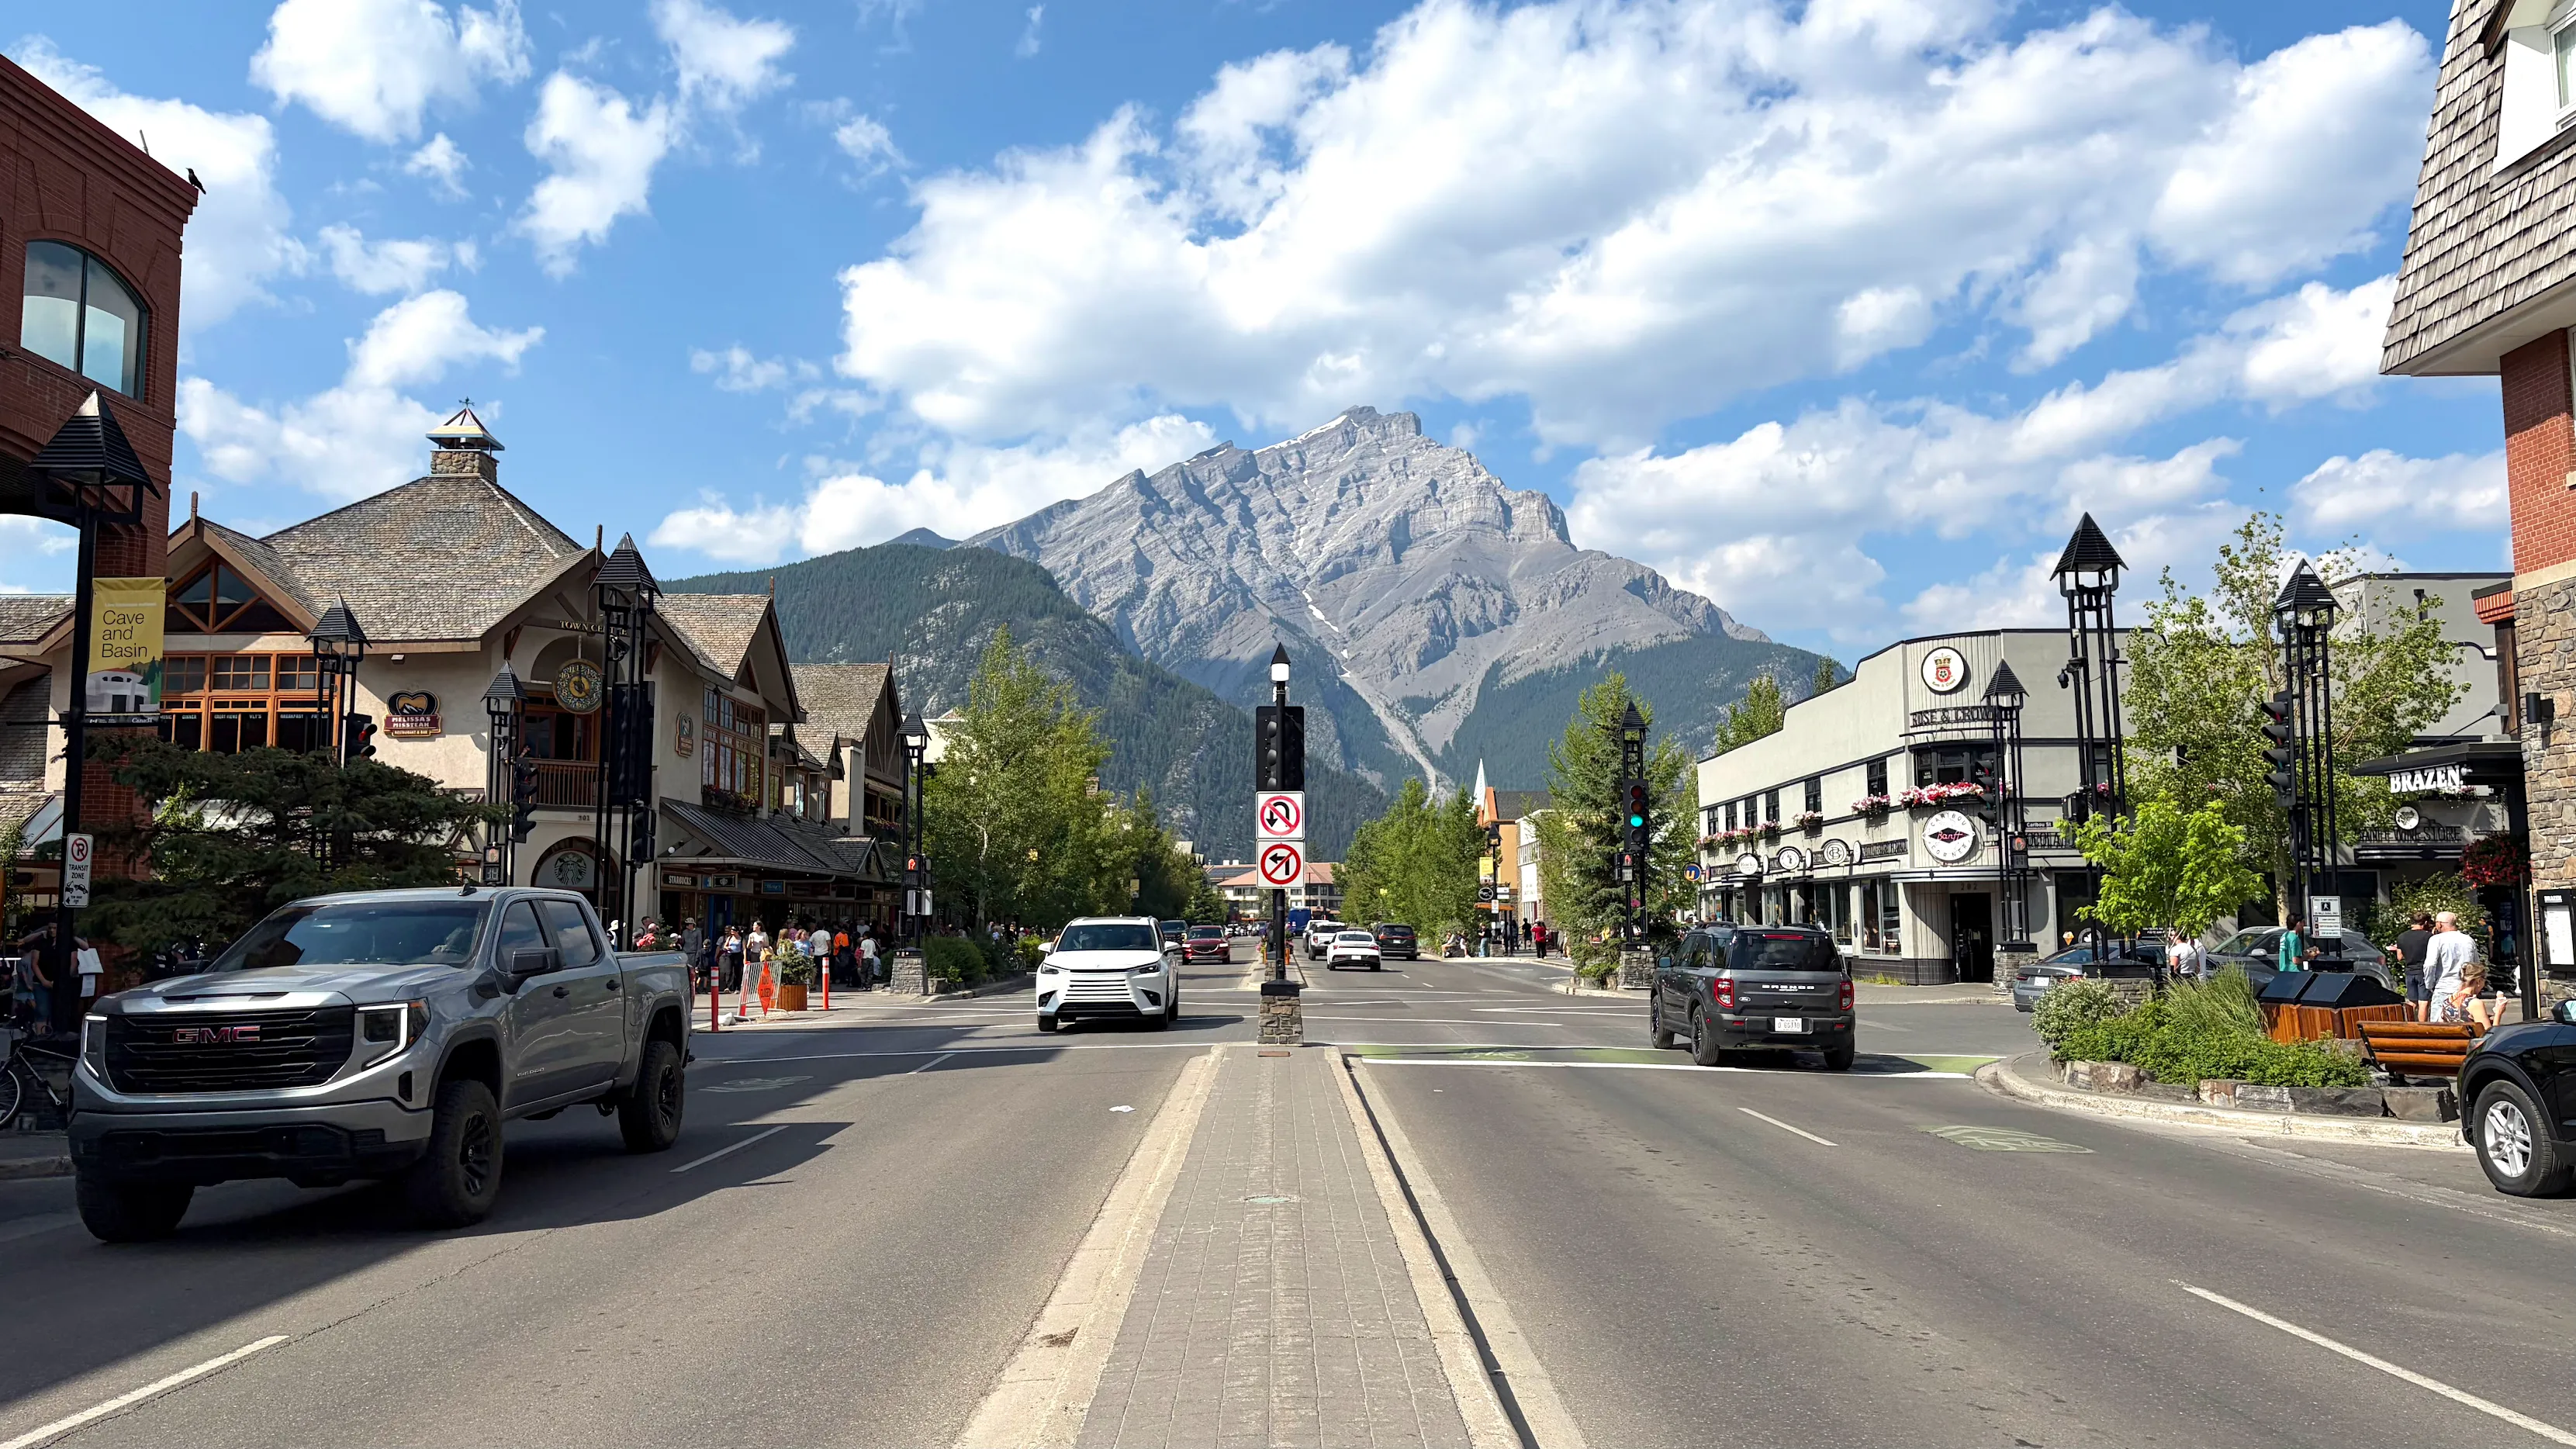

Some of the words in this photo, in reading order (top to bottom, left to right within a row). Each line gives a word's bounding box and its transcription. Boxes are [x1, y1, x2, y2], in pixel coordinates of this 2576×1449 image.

[102, 610, 145, 625] Cave
[102, 625, 133, 641] and
[559, 620, 589, 631] TOWN
[102, 643, 148, 658] Basin
[1912, 711, 1938, 726] ROSE
[1941, 709, 1951, 721] &
[1930, 812, 1967, 828] CARIBOU
[1937, 831, 1963, 841] Banff
[2423, 826, 2461, 841] STORE
[1931, 842, 1968, 858] CORNER
[68, 863, 88, 872] TRANSIT
[669, 875, 692, 886] STARBUCKS
[172, 1025, 261, 1044] GMC
